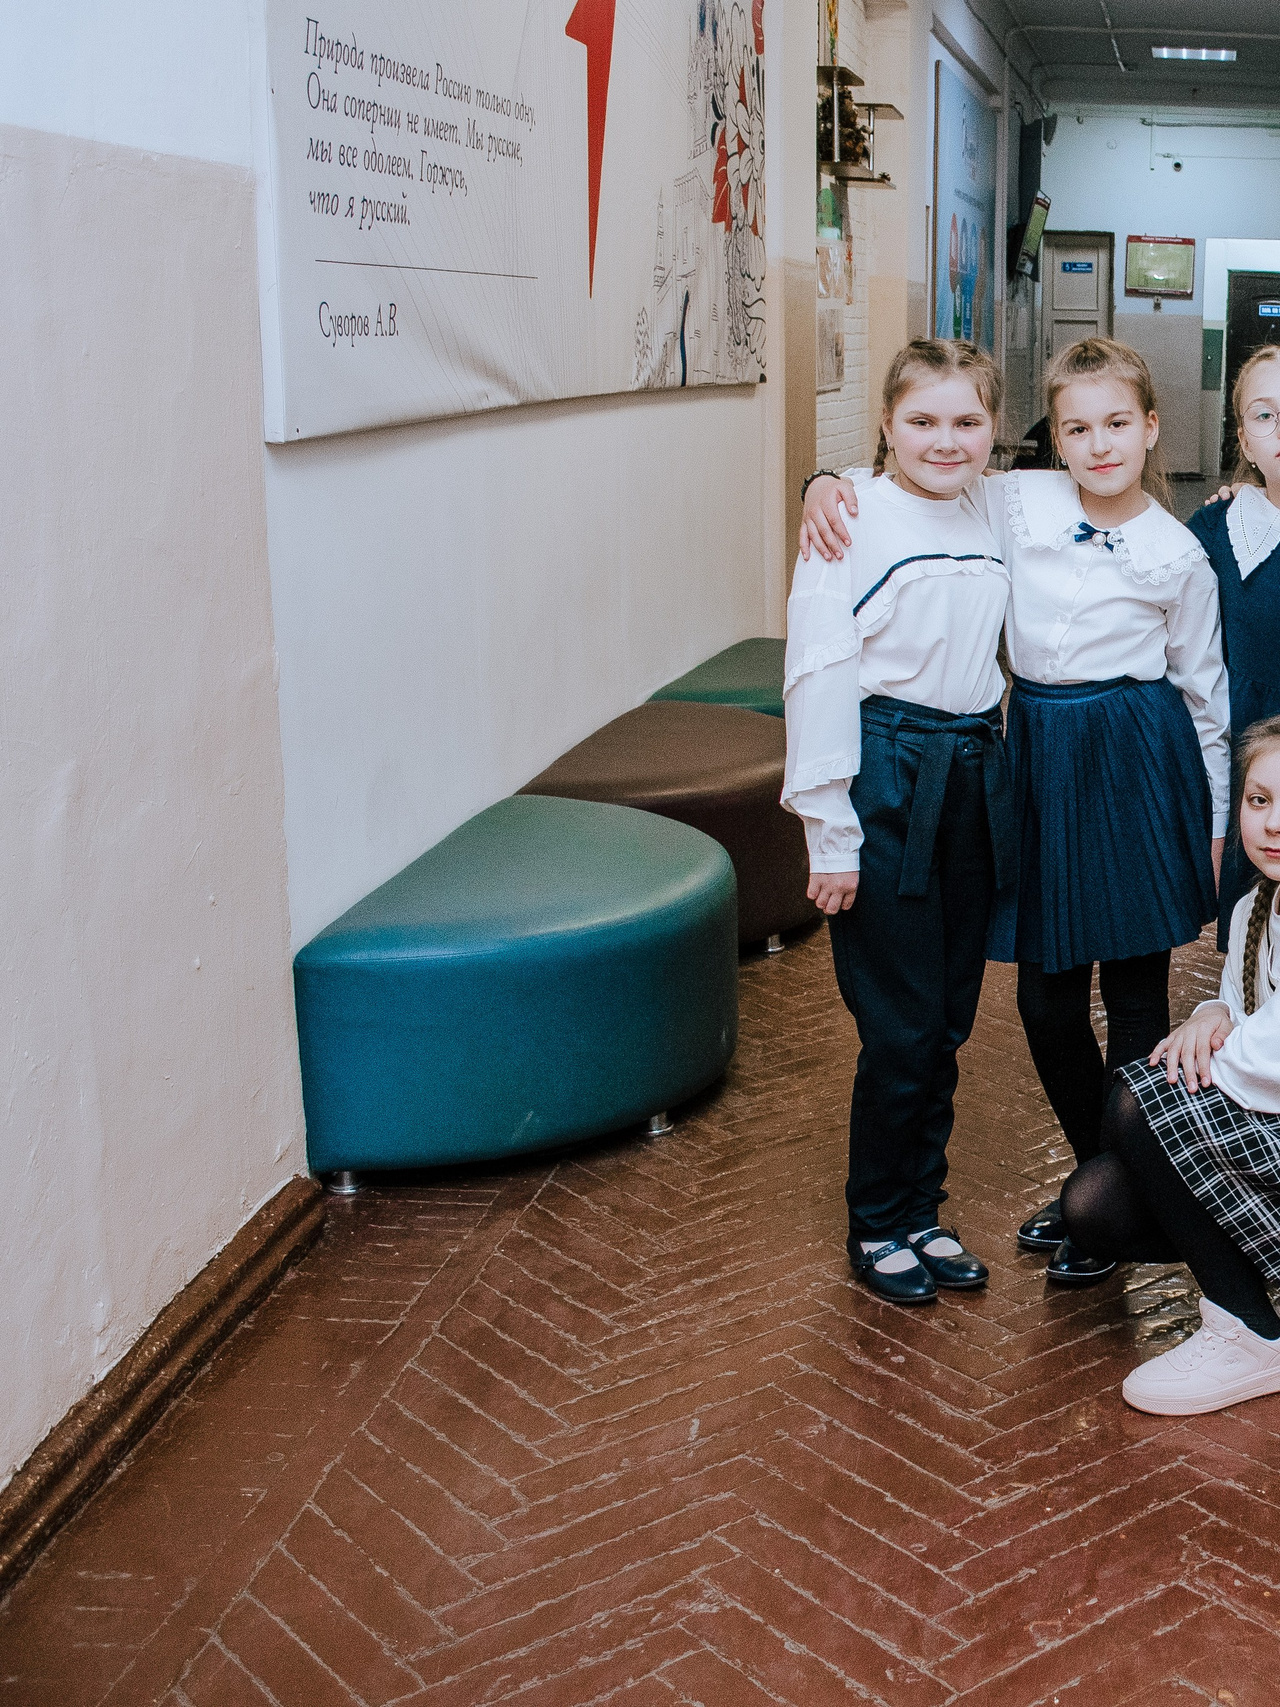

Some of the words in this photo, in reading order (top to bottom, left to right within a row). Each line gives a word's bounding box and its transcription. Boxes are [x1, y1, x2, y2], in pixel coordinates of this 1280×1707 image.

[304, 17, 364, 75] Природа
[370, 53, 430, 91] произвела
[434, 62, 472, 104] Россию
[475, 89, 512, 117] только
[514, 92, 536, 132] одну.
[307, 71, 338, 113] Она
[343, 95, 401, 137] соперниц
[406, 112, 419, 134] не
[423, 117, 461, 146] имеет.
[465, 117, 484, 151] Мы
[487, 132, 523, 167] русские,
[306, 137, 333, 164] мы
[338, 144, 358, 169] все
[363, 137, 414, 180] одолеем.
[419, 149, 468, 197] Горжусь,
[308, 190, 340, 217] что
[344, 196, 356, 218] я
[358, 191, 411, 231] русский.
[318, 301, 370, 348] Суворов
[374, 303, 399, 337] А.В.
